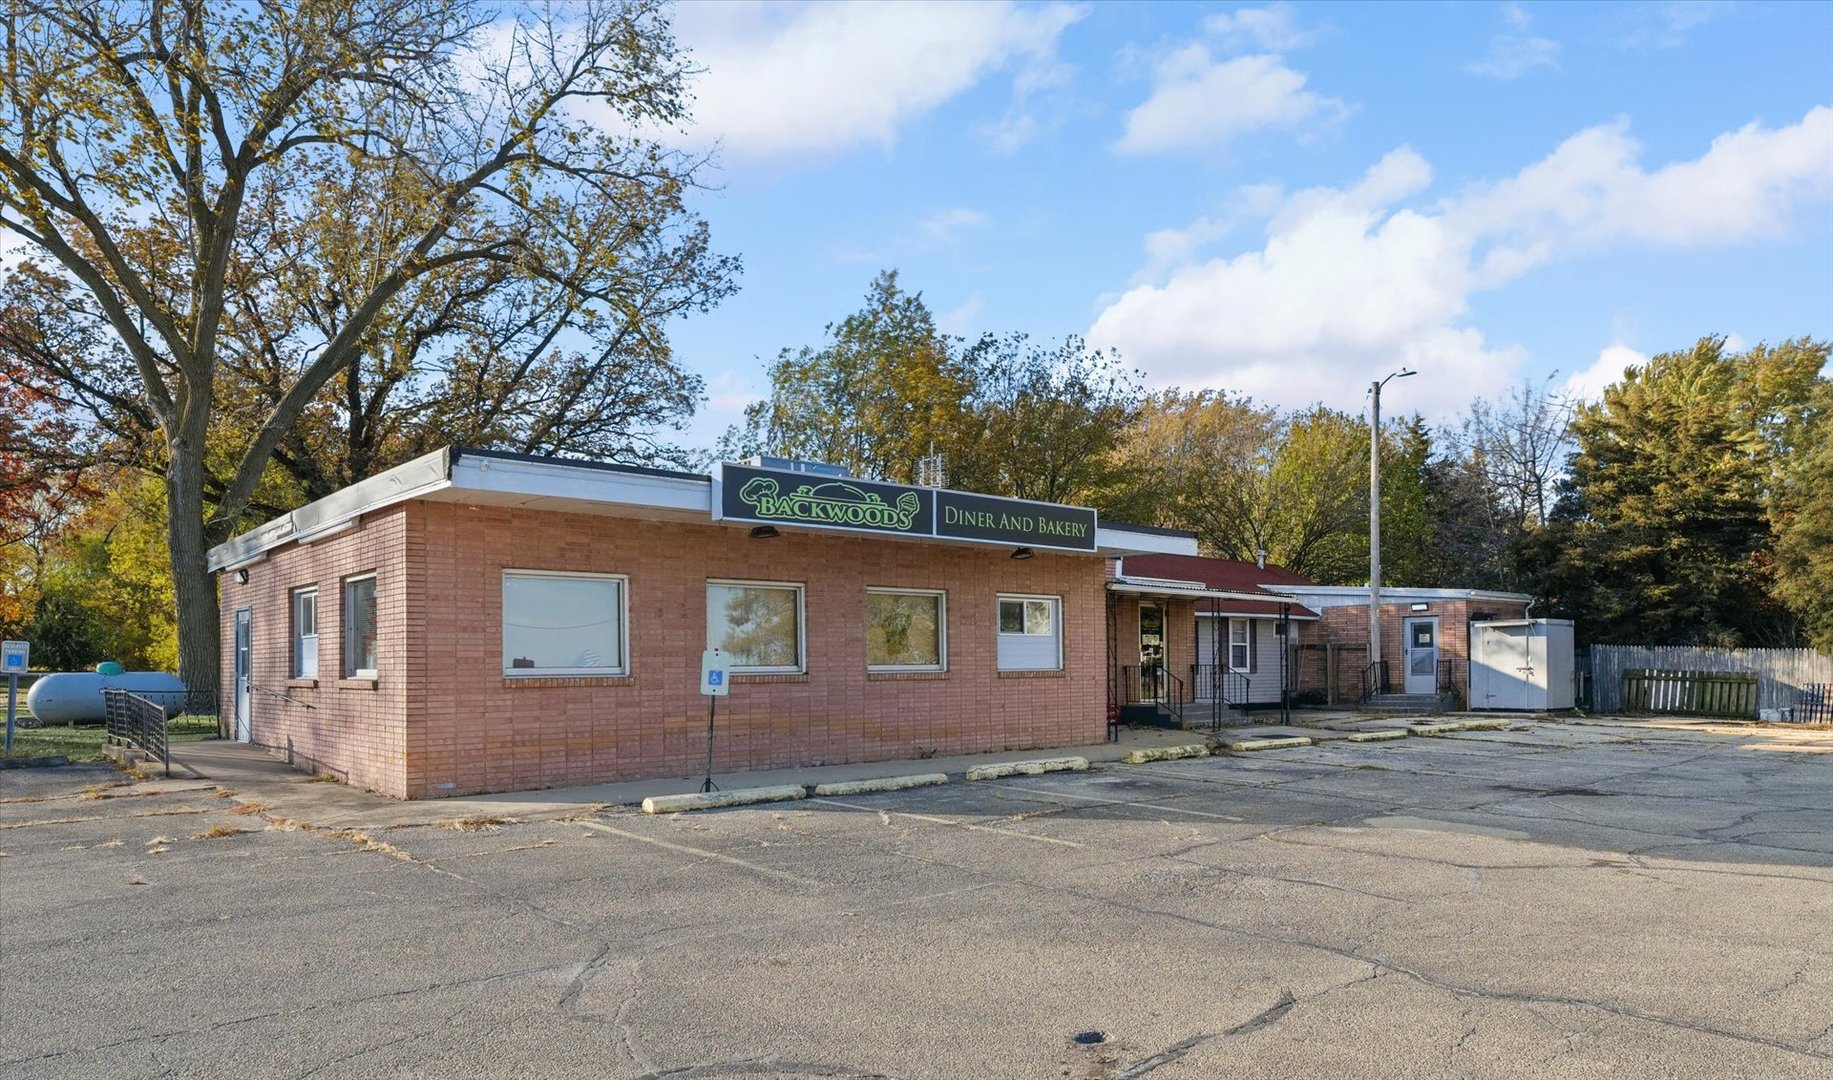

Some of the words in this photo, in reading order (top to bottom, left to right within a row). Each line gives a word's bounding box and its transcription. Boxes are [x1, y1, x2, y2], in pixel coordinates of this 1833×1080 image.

[758, 497, 911, 528] BACKWOODS
[945, 506, 996, 529] DINER
[999, 513, 1034, 532] AND
[1039, 516, 1087, 537] BAKERY
